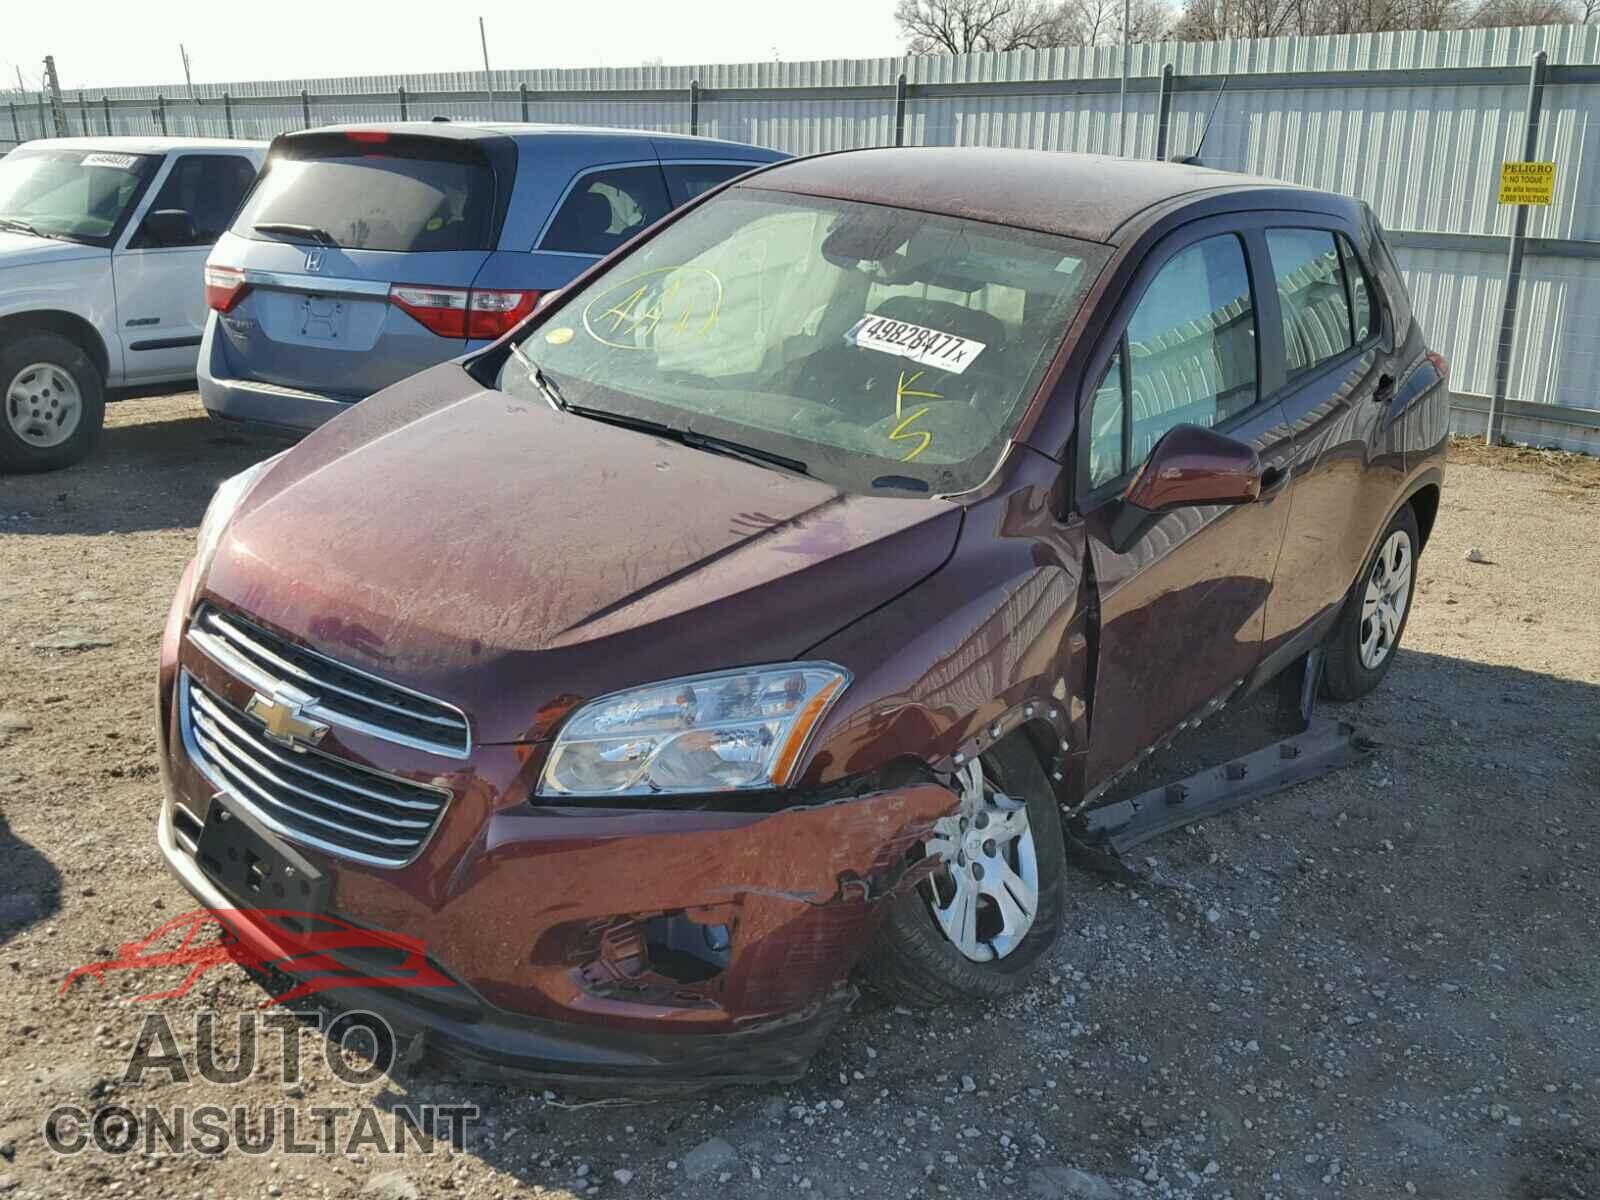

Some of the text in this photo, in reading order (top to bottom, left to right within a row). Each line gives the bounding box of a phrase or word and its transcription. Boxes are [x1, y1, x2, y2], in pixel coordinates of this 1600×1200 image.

[1504, 164, 1552, 173] PELIGRO
[1510, 175, 1519, 184] NO
[1521, 175, 1542, 184] TOQUE
[895, 370, 944, 419] K
